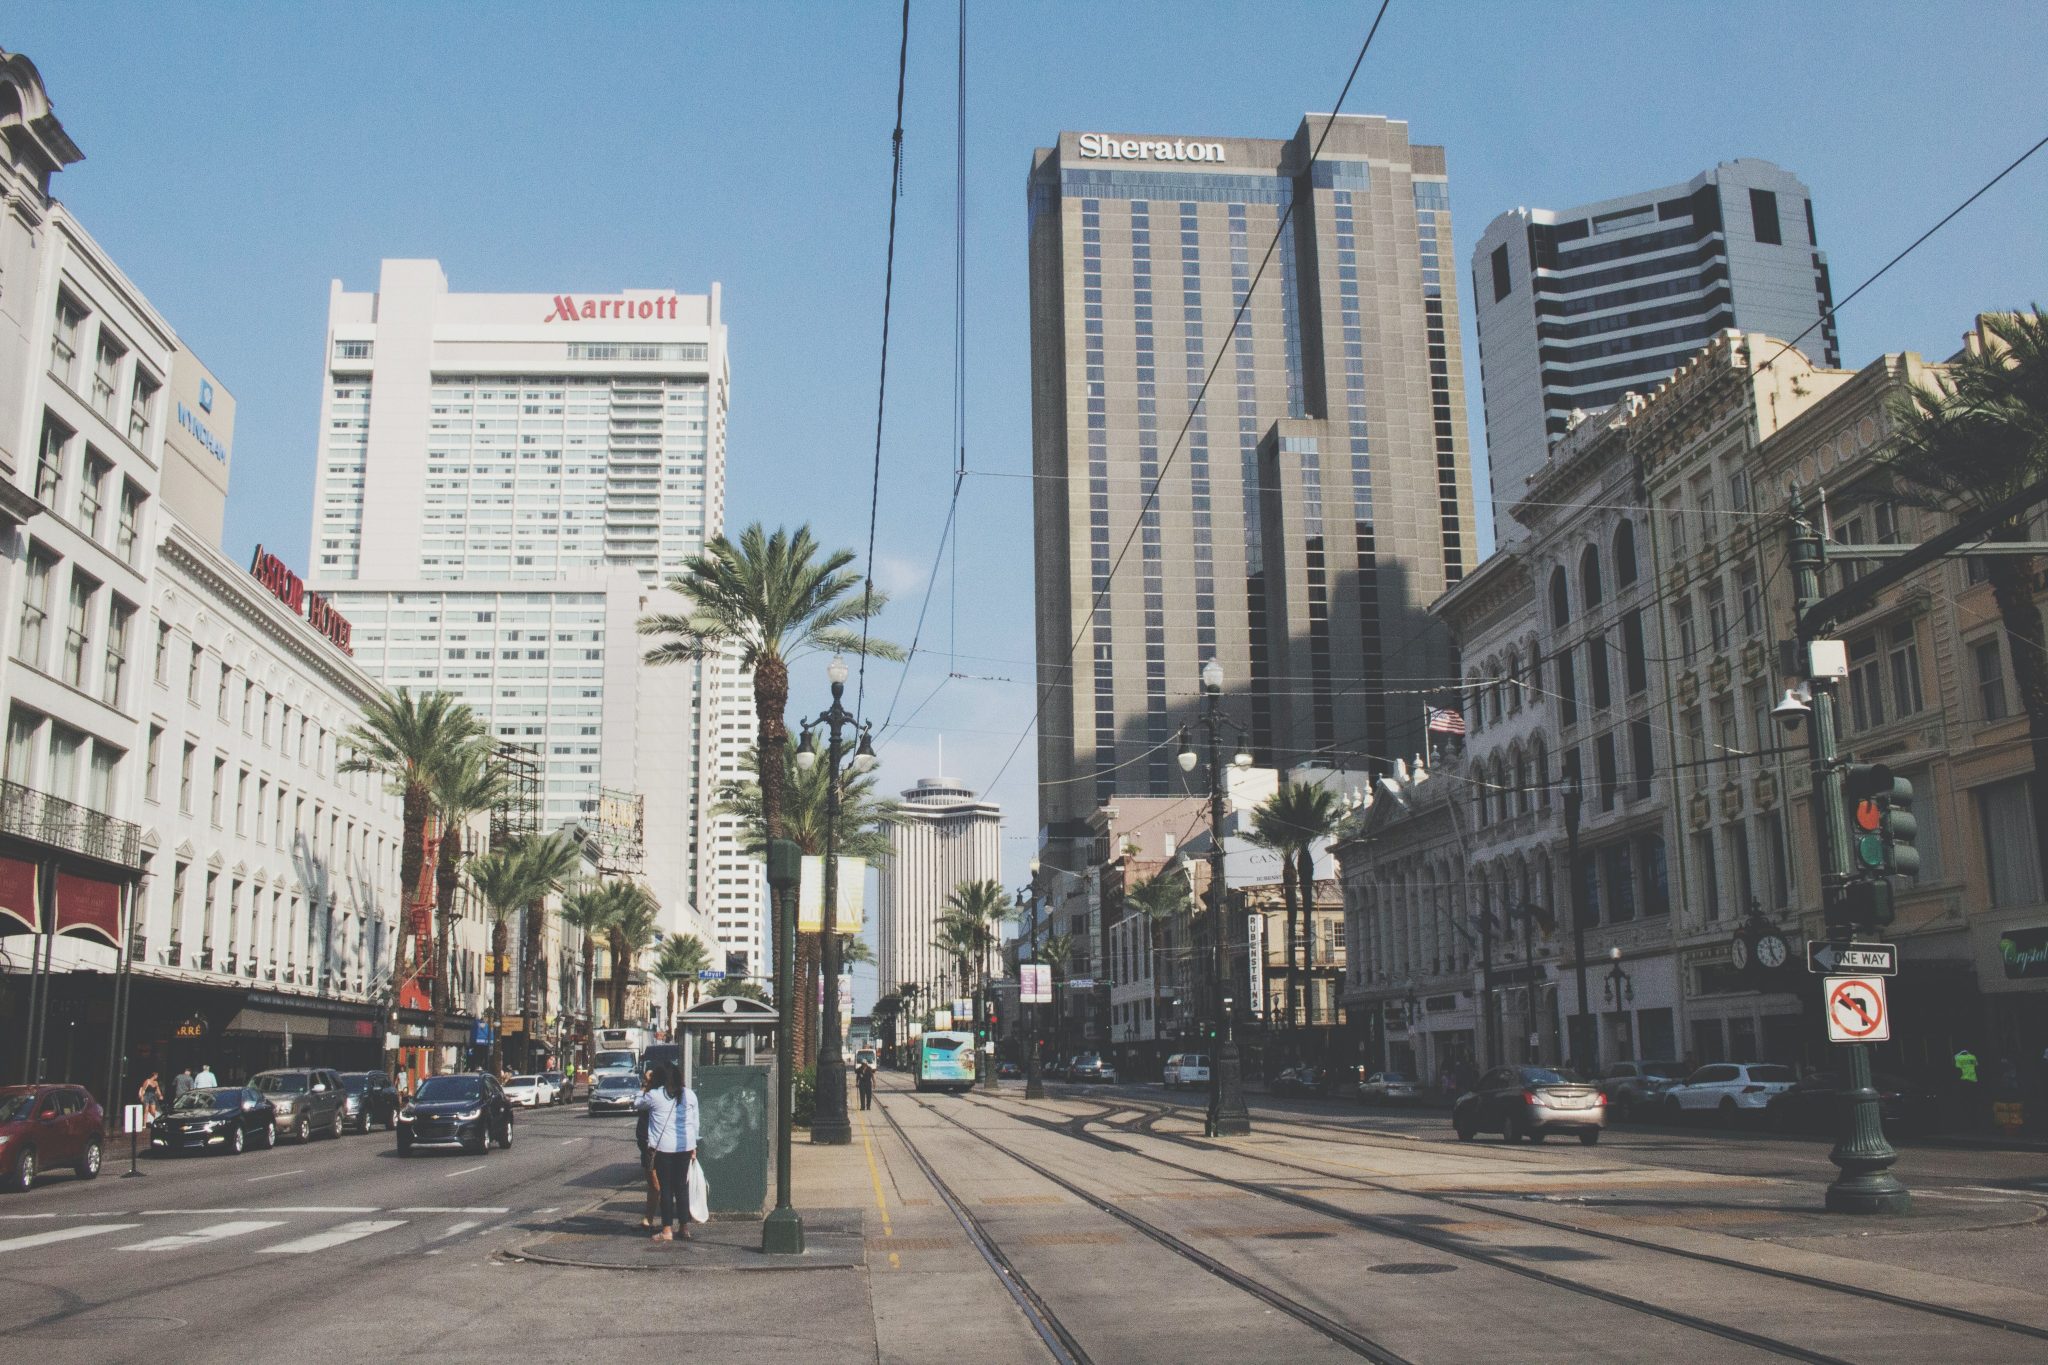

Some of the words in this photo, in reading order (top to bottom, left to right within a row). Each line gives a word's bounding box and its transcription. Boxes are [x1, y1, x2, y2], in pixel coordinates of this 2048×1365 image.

[1079, 133, 1226, 163] Sheraton
[543, 294, 679, 324] Marriott
[178, 400, 227, 466] WYNDHAM
[250, 543, 305, 617] ASTOR
[309, 591, 354, 657] HOTEL
[1250, 916, 1258, 1008] RUBENSTEINS
[1834, 951, 1858, 965] ONE
[1861, 953, 1886, 966] WAY
